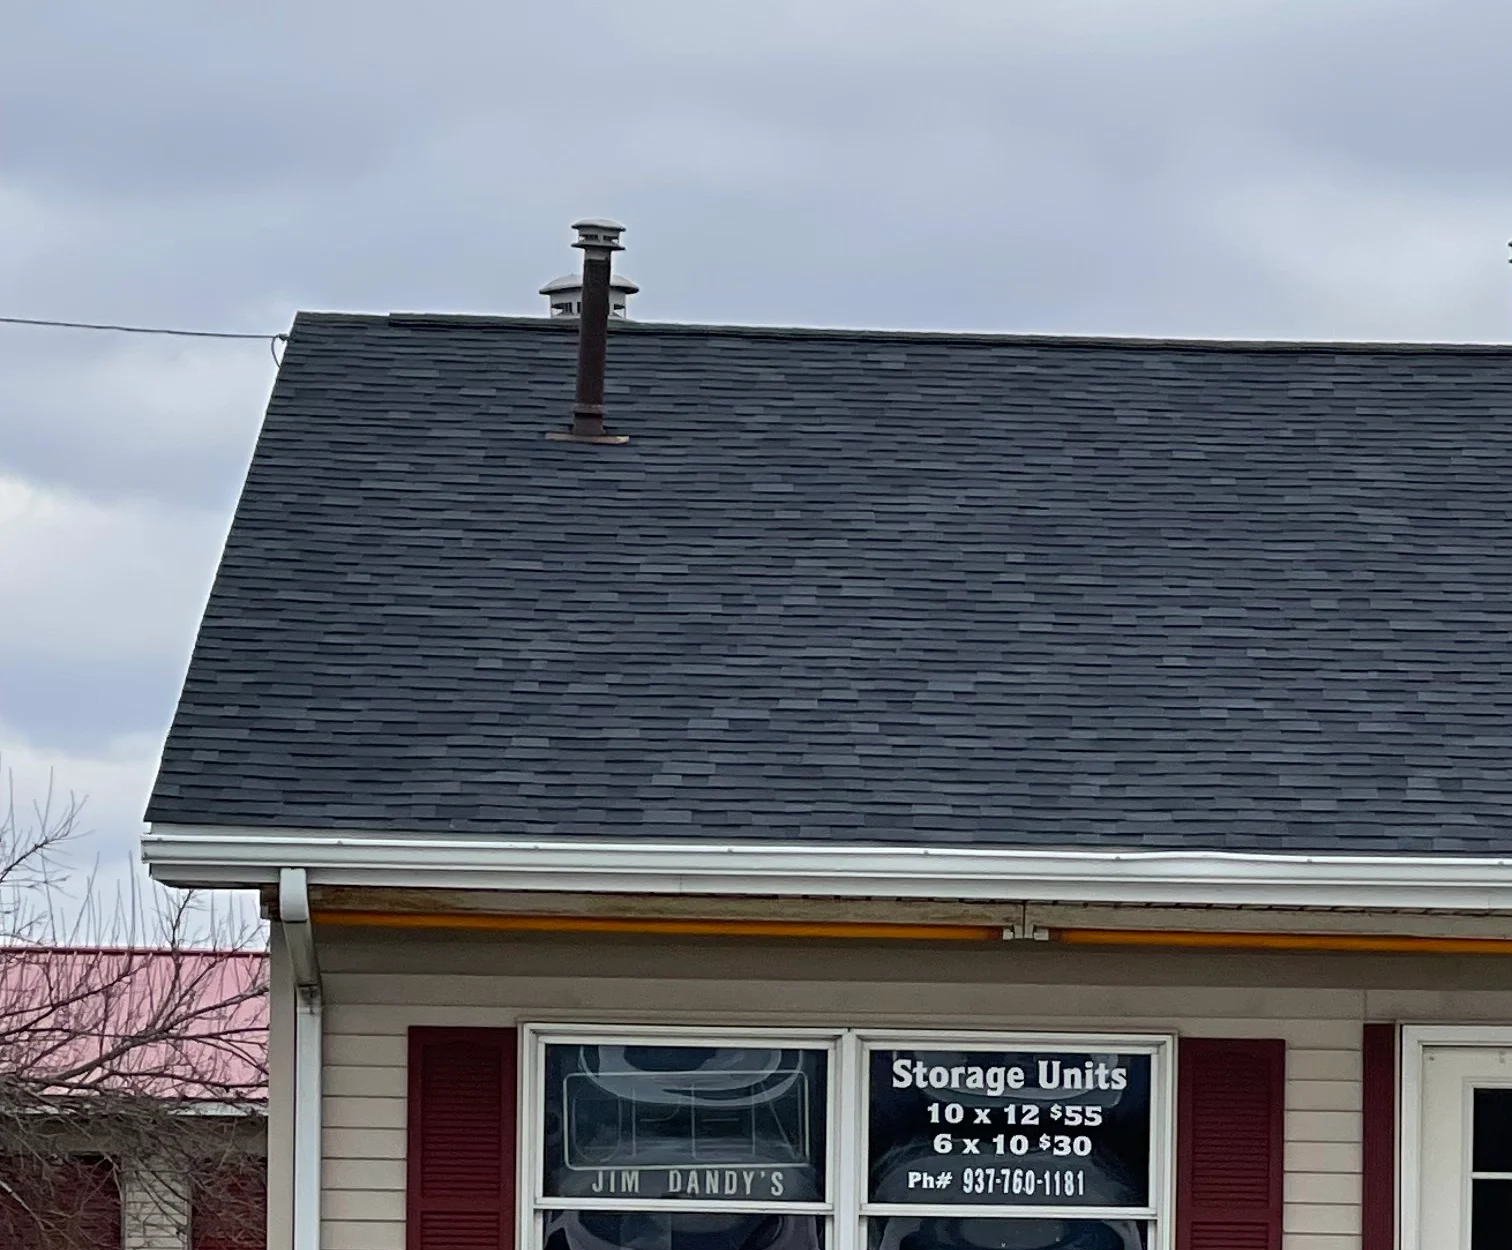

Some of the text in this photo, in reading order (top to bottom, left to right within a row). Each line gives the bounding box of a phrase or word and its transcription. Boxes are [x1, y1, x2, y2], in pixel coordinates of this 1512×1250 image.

[892, 1058, 1127, 1097] Storage Units
[927, 1103, 1102, 1126] 10 x 12 $55
[933, 1133, 1092, 1156] 6 x 10 $30
[591, 1169, 784, 1196] JIM DANDY'S
[908, 1168, 1084, 1196] Ph# 937-760-1181
